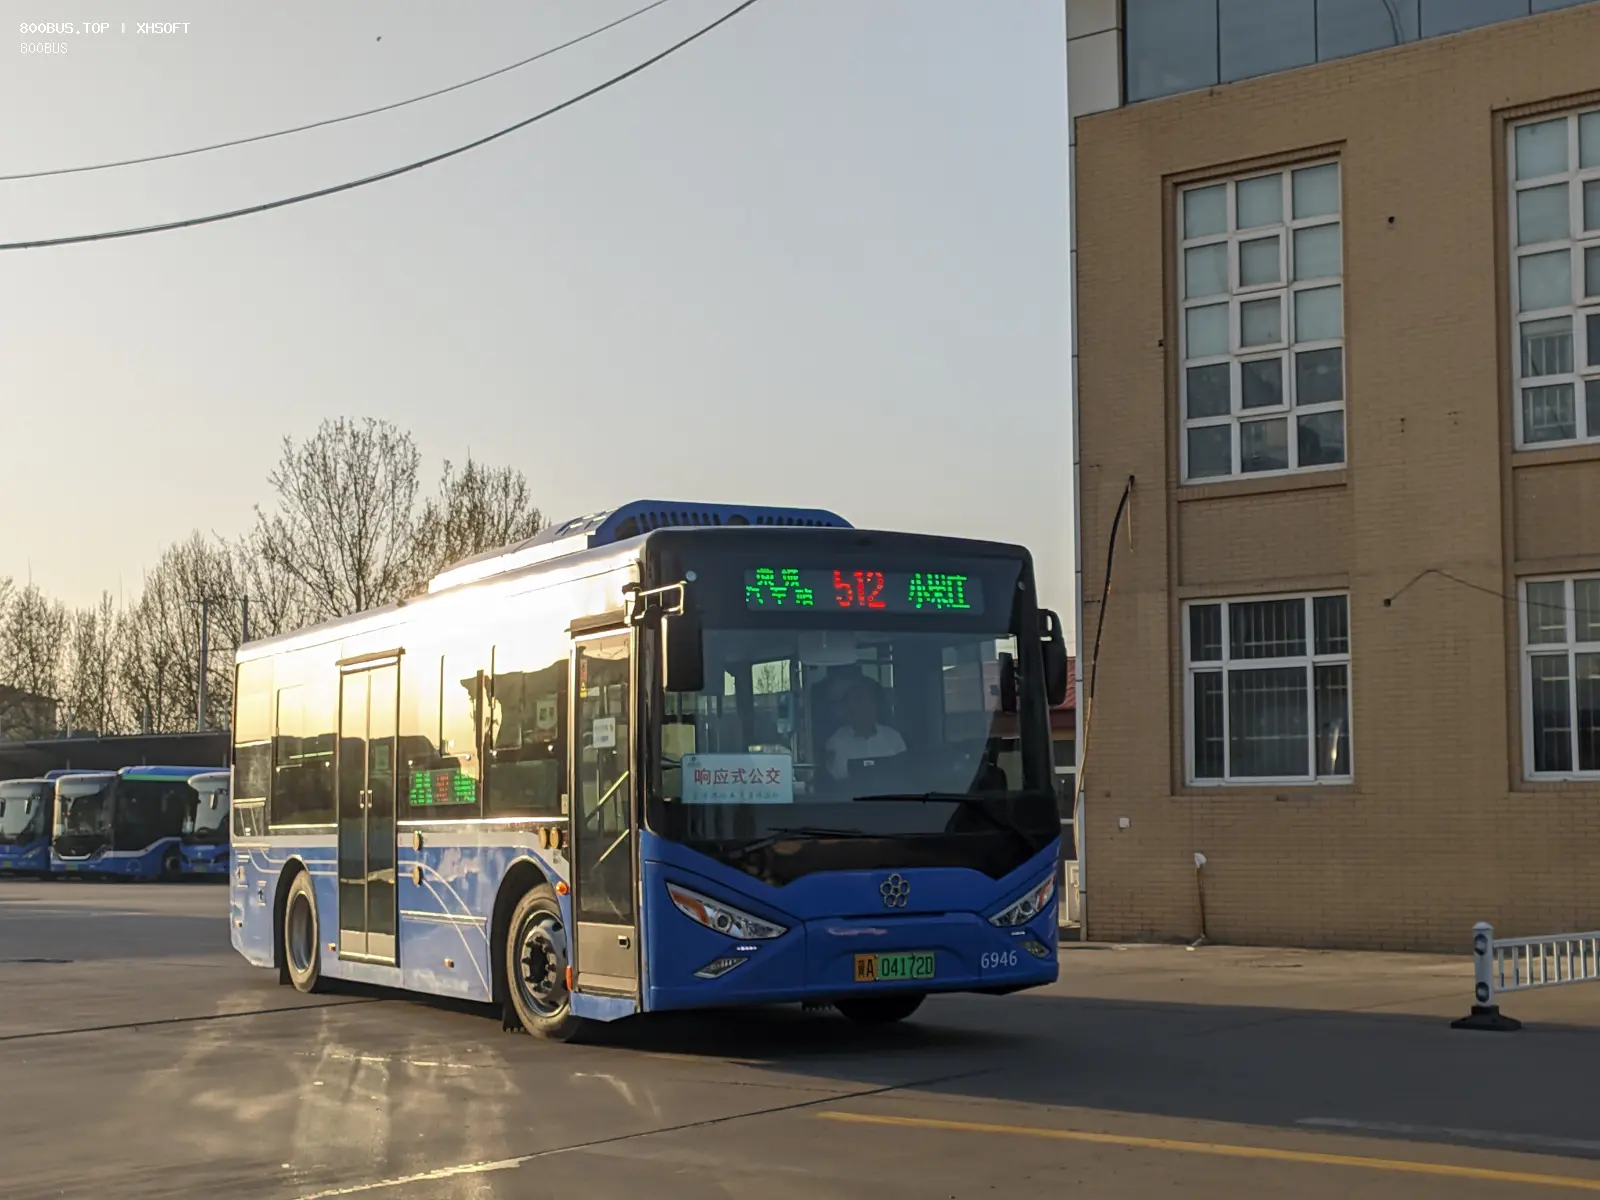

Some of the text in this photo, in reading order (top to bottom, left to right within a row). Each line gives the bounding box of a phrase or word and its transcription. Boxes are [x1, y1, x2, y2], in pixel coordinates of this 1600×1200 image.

[833, 569, 886, 608] 512
[694, 767, 781, 785] 响应式公交
[980, 950, 1018, 969] 6946
